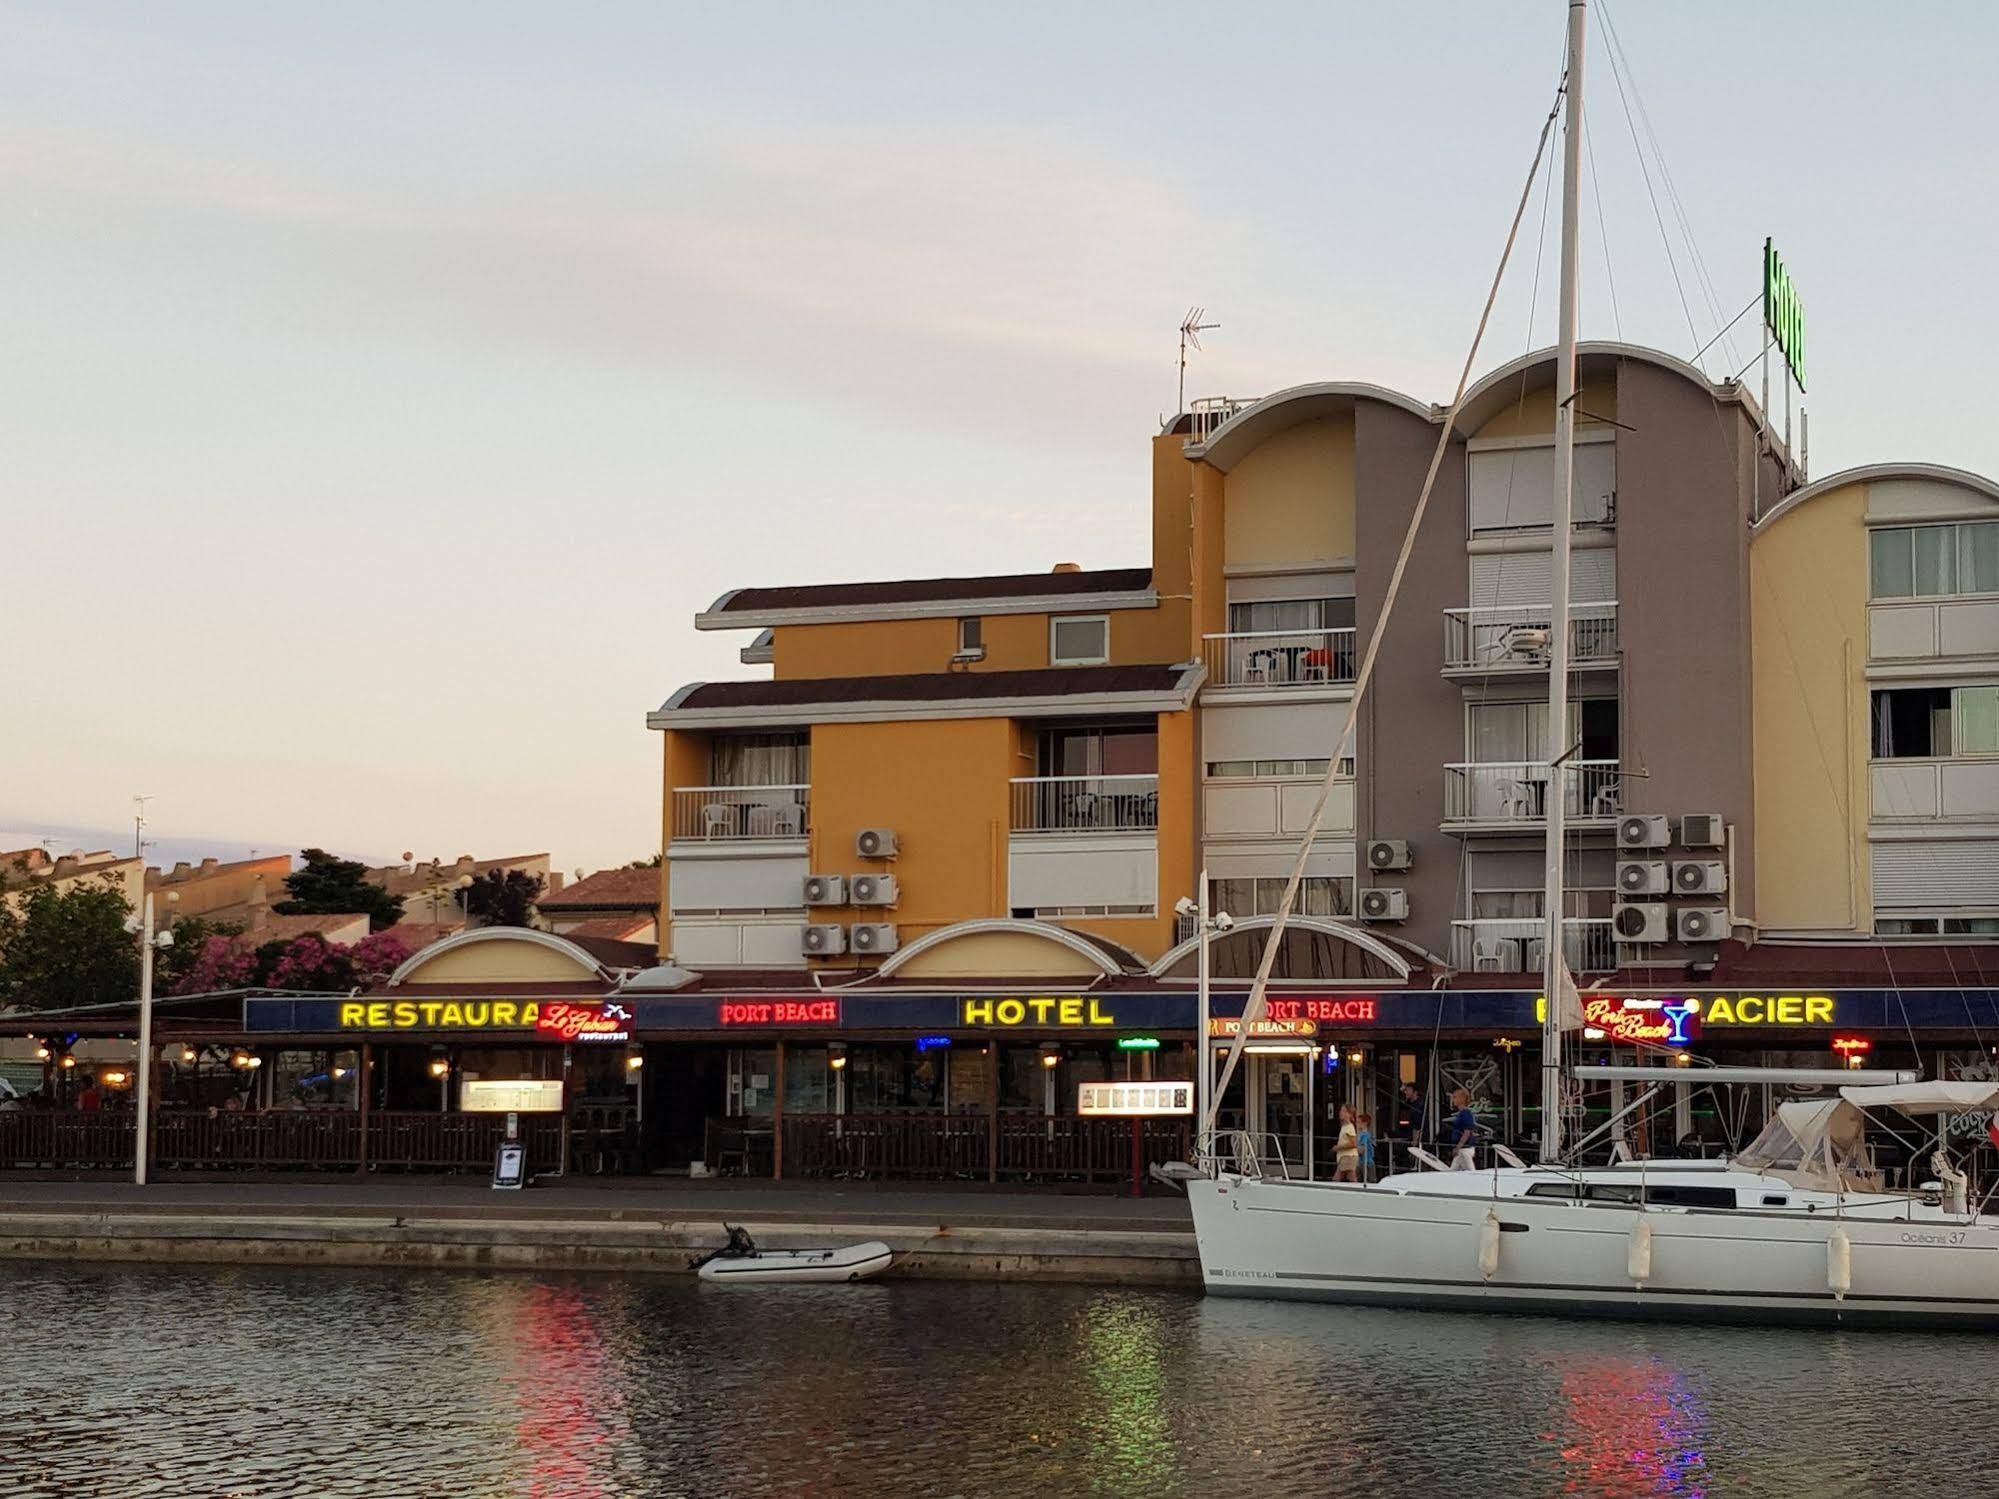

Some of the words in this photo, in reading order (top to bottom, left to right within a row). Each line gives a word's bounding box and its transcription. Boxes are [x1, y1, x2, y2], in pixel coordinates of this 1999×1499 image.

[1765, 237, 1808, 393] HOTEL
[341, 1002, 539, 1027] RESTAURA
[539, 1004, 569, 1029] Le
[721, 1003, 772, 1023] PORT
[774, 1001, 837, 1022] BEACH
[965, 998, 1114, 1025] HOTEL
[1266, 1001, 1302, 1019] ORT
[1307, 1000, 1376, 1020] BEACH
[1584, 998, 1627, 1024] Port
[1611, 1013, 1673, 1038] Beach
[1701, 997, 1834, 1024] ACIER
[1225, 1021, 1256, 1033] POT
[1257, 1021, 1295, 1033] BEACH
[1949, 1231, 1966, 1244] 37
